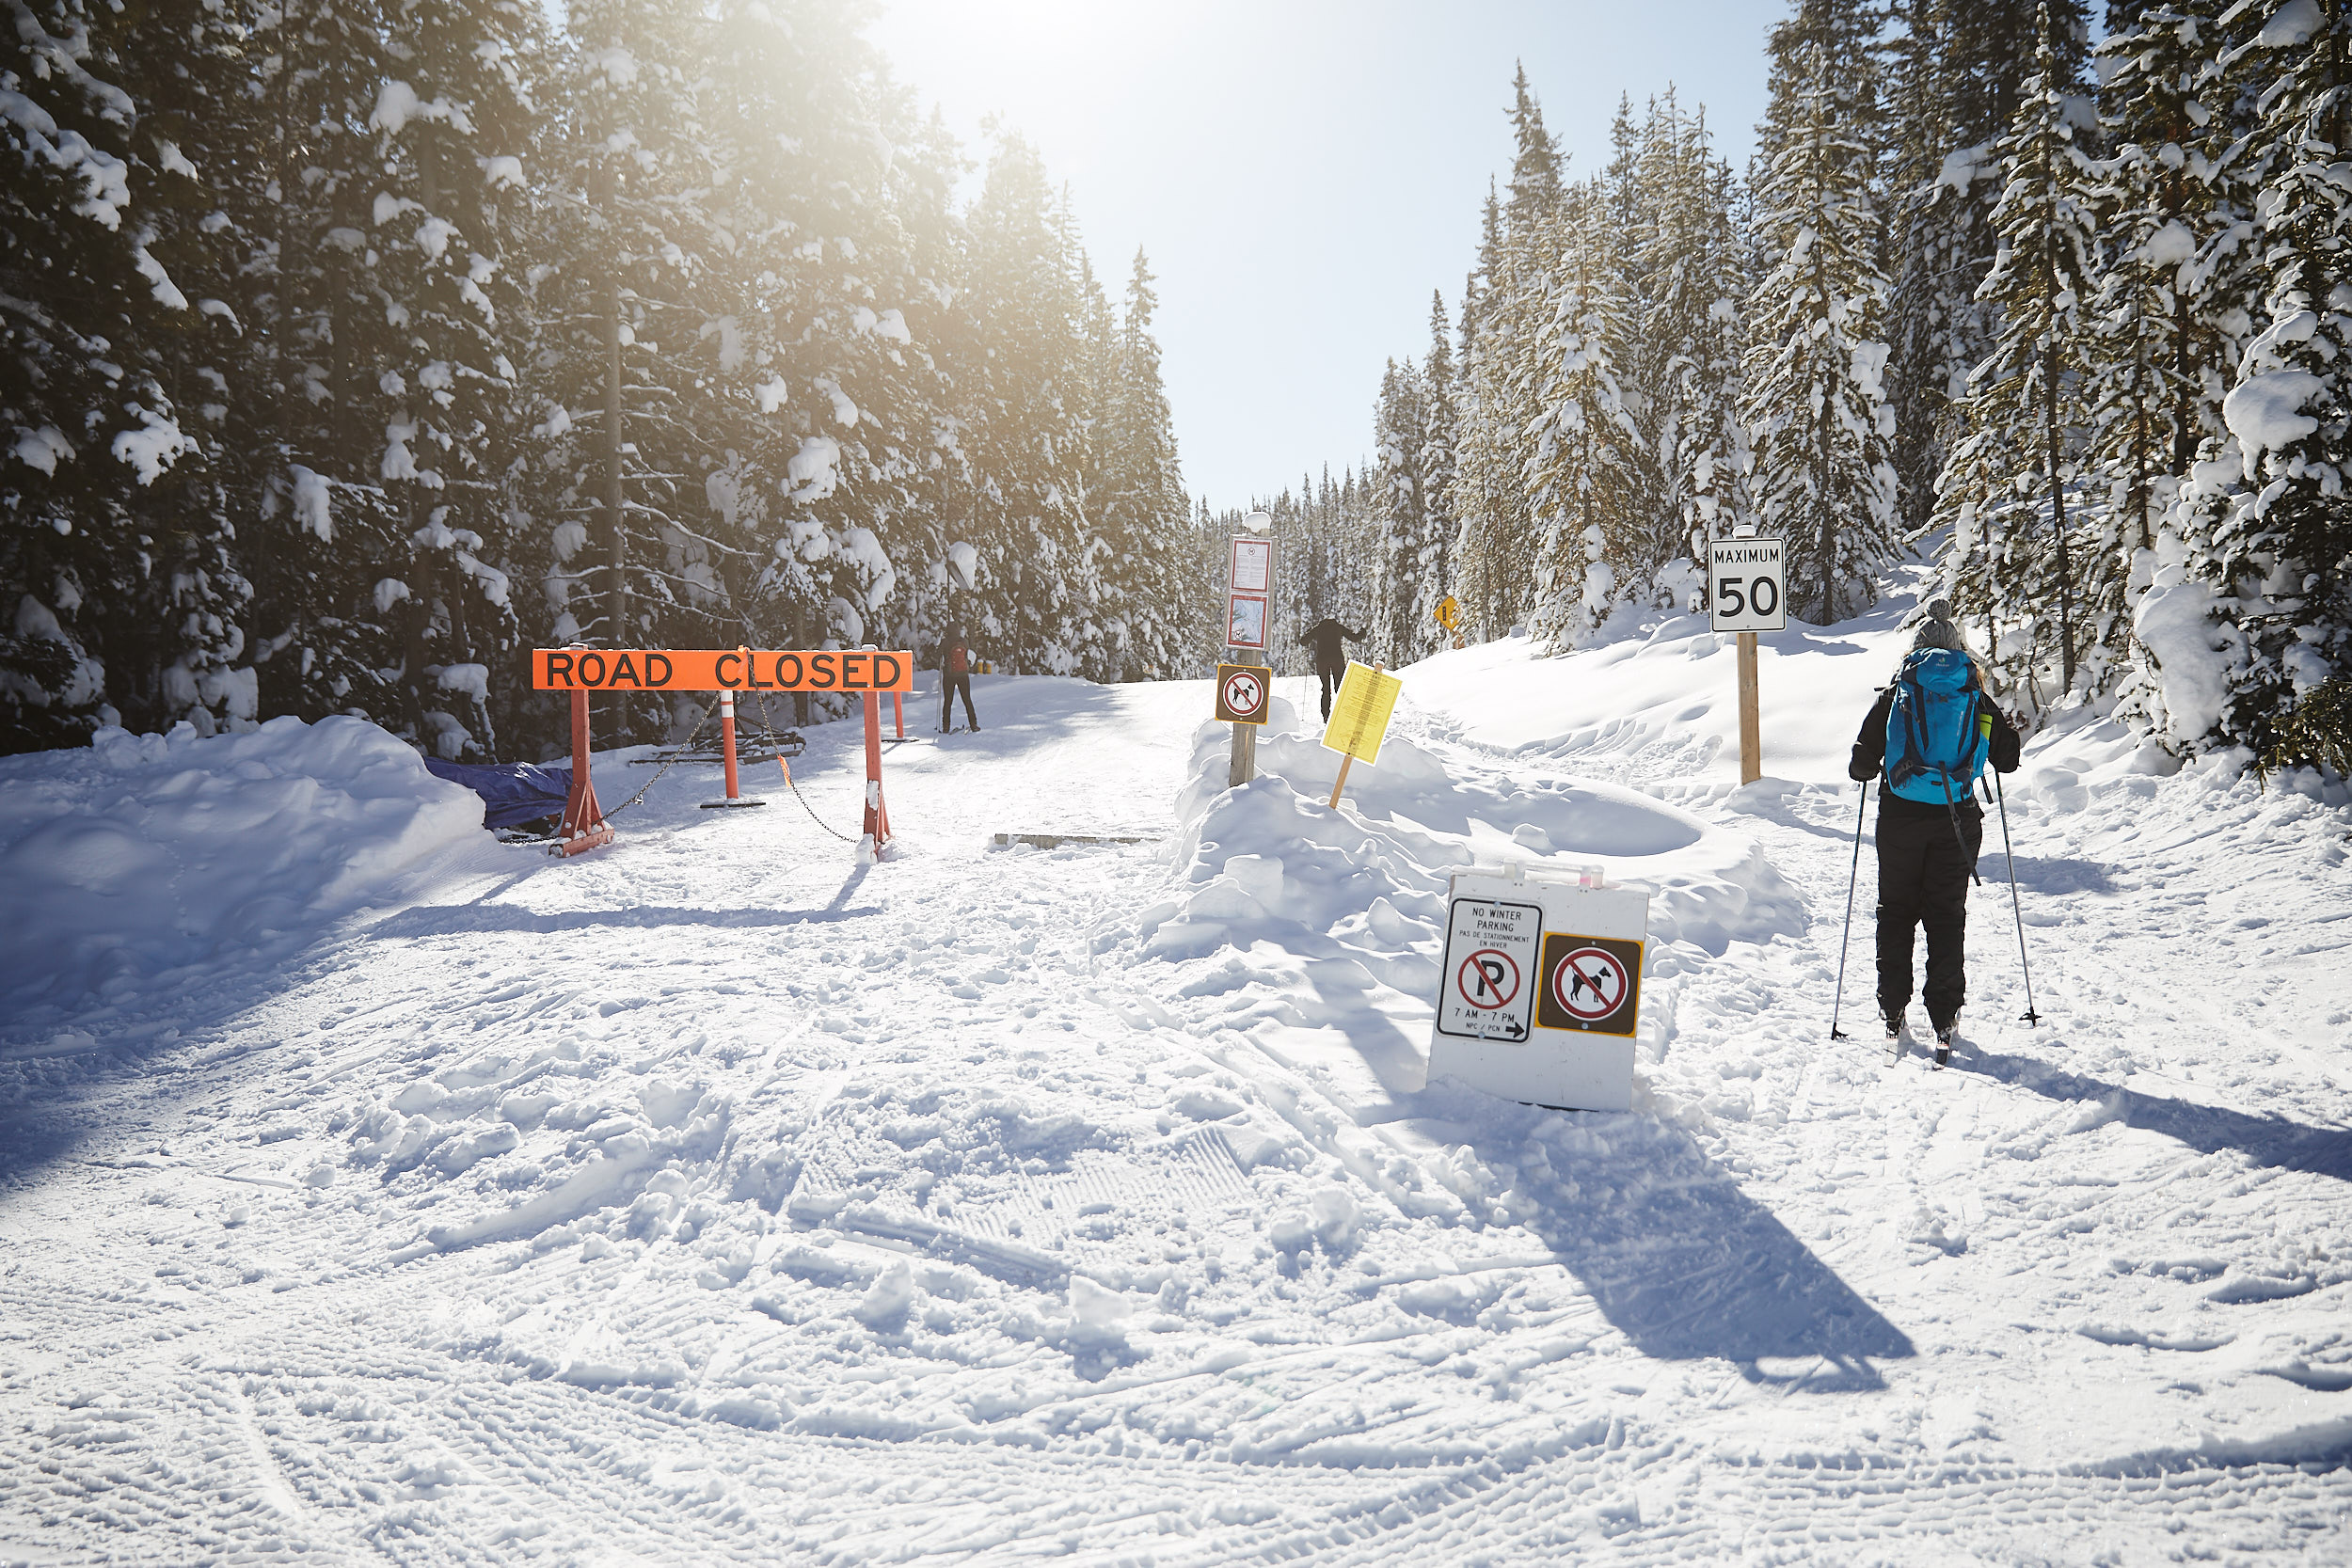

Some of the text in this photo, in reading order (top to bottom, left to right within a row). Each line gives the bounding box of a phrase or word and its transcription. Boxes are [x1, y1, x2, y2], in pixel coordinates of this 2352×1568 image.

[1714, 548, 1779, 563] MAXIMUM
[1719, 576, 1778, 617] 50
[547, 653, 901, 689] ROAD CLOSED
[1472, 907, 1521, 921] NO WINTER
[1477, 920, 1514, 932] PARKING
[1484, 932, 1530, 942] STATIONNEMENT
[1489, 941, 1507, 949] HIVER
[1477, 959, 1504, 997] P
[1454, 1007, 1460, 1017] 7
[1465, 1008, 1478, 1019] AM
[1491, 1011, 1498, 1022] 7
[1502, 1012, 1515, 1022] PM
